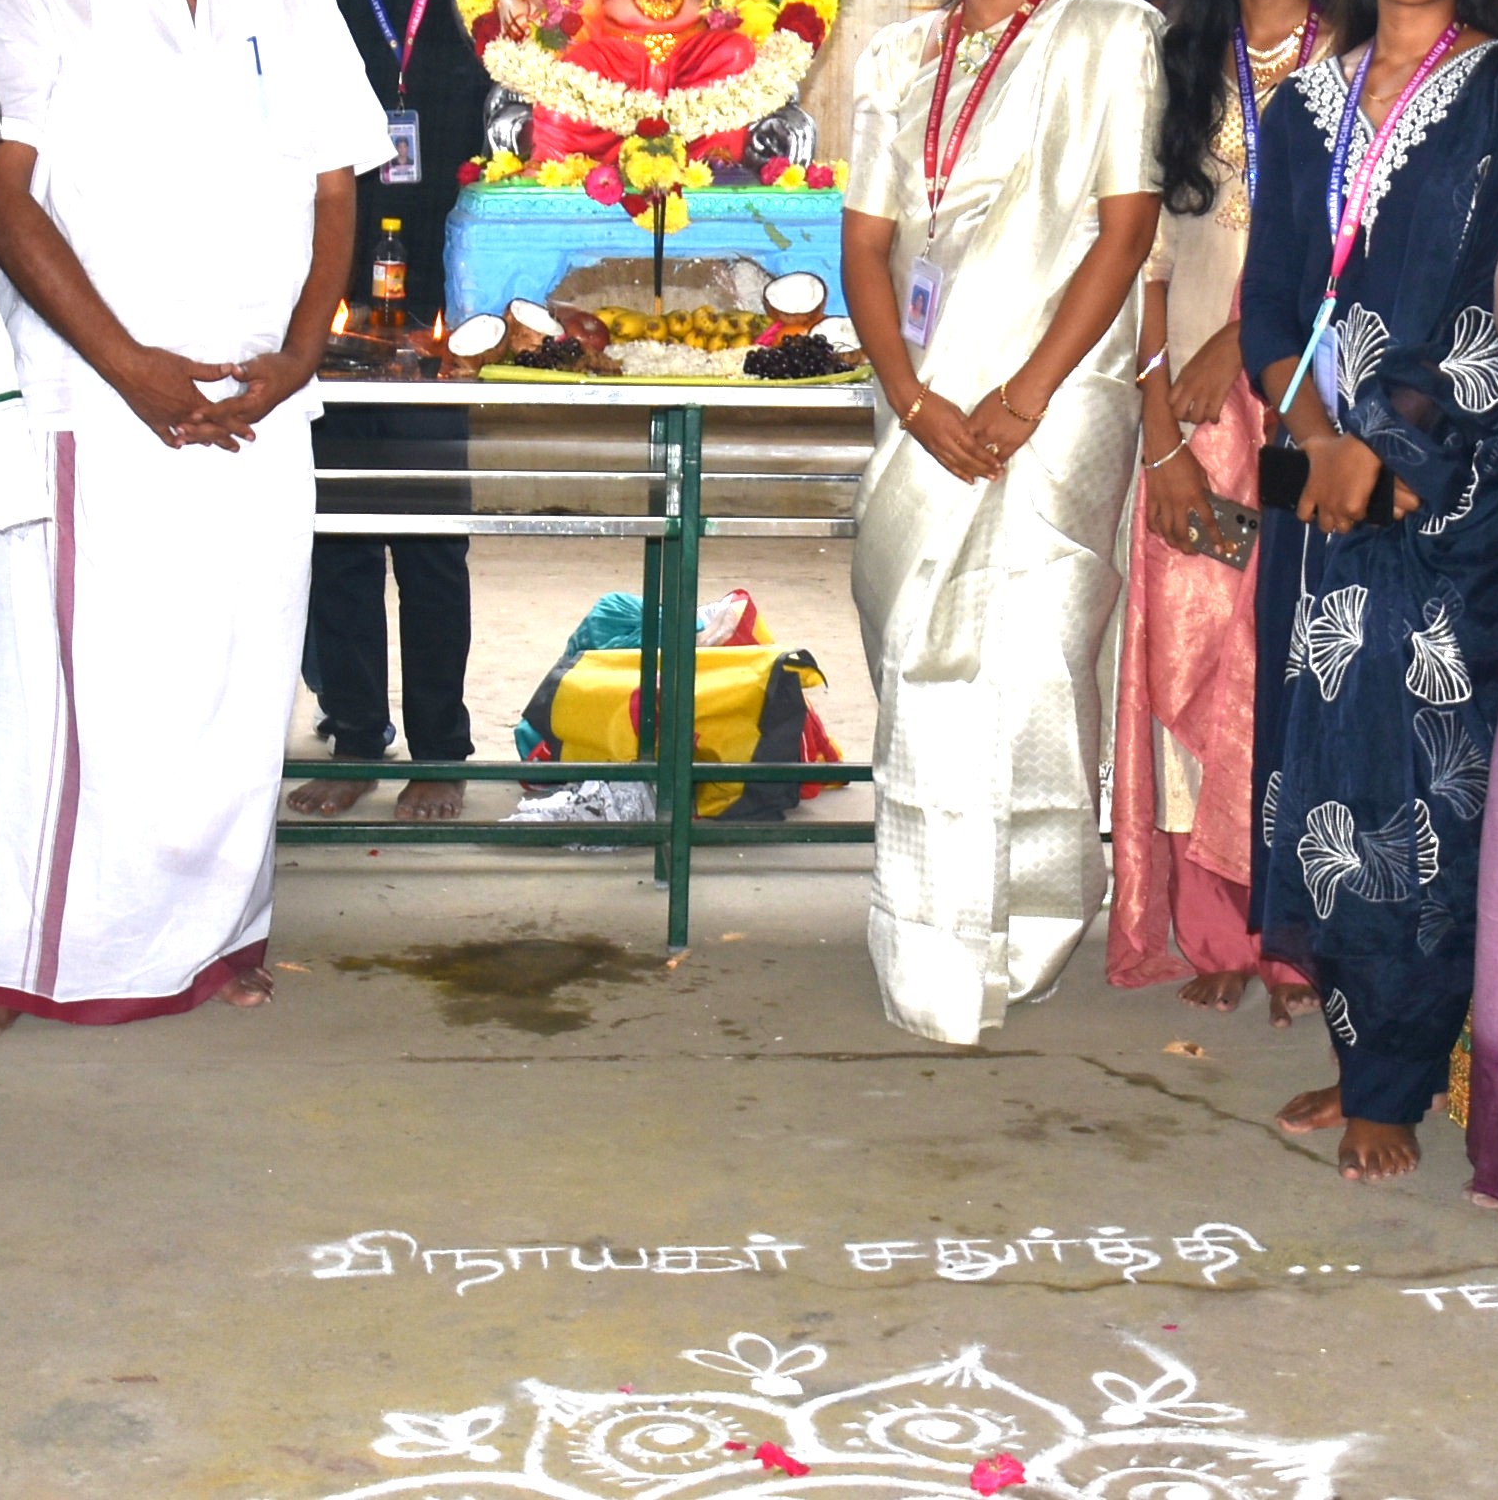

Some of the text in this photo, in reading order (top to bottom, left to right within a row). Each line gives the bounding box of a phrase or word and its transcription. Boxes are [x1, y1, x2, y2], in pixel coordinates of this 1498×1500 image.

[1243, 95, 1254, 130] SCIENCE
[1338, 109, 1352, 144] SCIENCE
[1247, 131, 1255, 150] AND
[1348, 183, 1364, 221] JAIRAM
[1359, 158, 1373, 182] ARTS
[1370, 137, 1383, 157] AND
[1379, 101, 1403, 136] SCIENCE
[1400, 67, 1427, 100] COLLEGE
[1424, 41, 1446, 66] SALEM
[1334, 145, 1344, 164] AND
[1330, 166, 1340, 189] ARTS
[1329, 192, 1337, 229] JAIRAM
[311, 1229, 805, 1296] விநாயகர்
